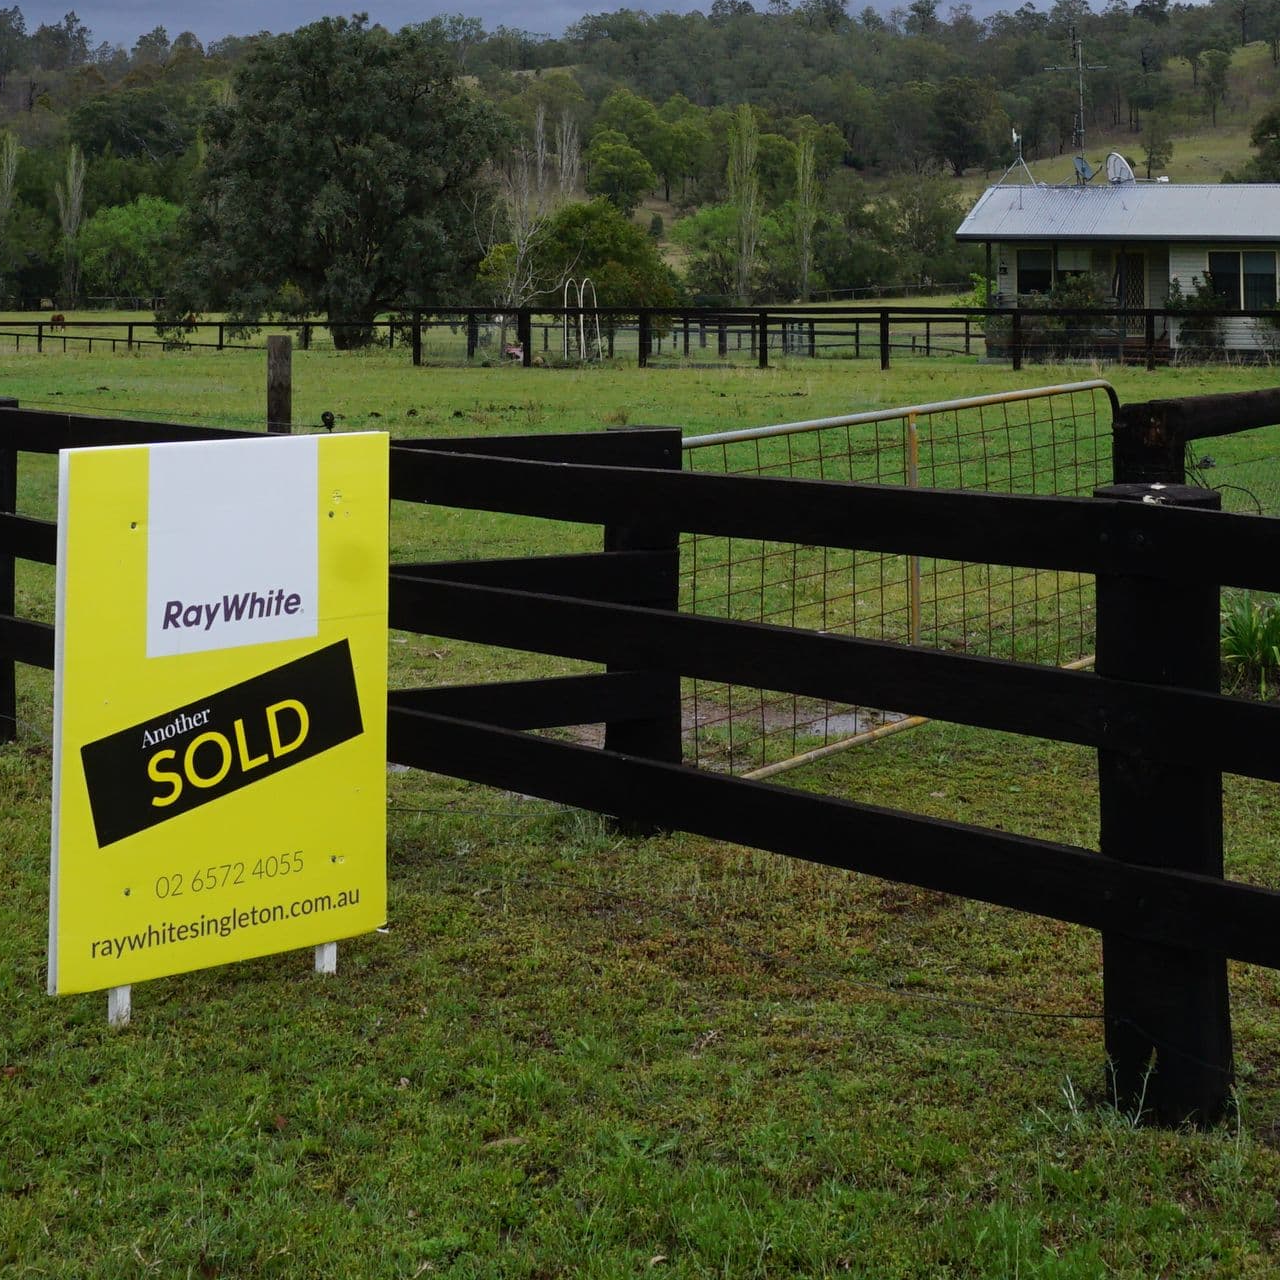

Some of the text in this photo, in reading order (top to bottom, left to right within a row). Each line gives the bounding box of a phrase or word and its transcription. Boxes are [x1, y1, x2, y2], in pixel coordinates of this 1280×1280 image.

[141, 708, 211, 749] Another
[147, 698, 310, 808] SOLD
[155, 850, 304, 899] 02 6572 4055
[91, 888, 361, 959] raywhitesingleton.com.au
